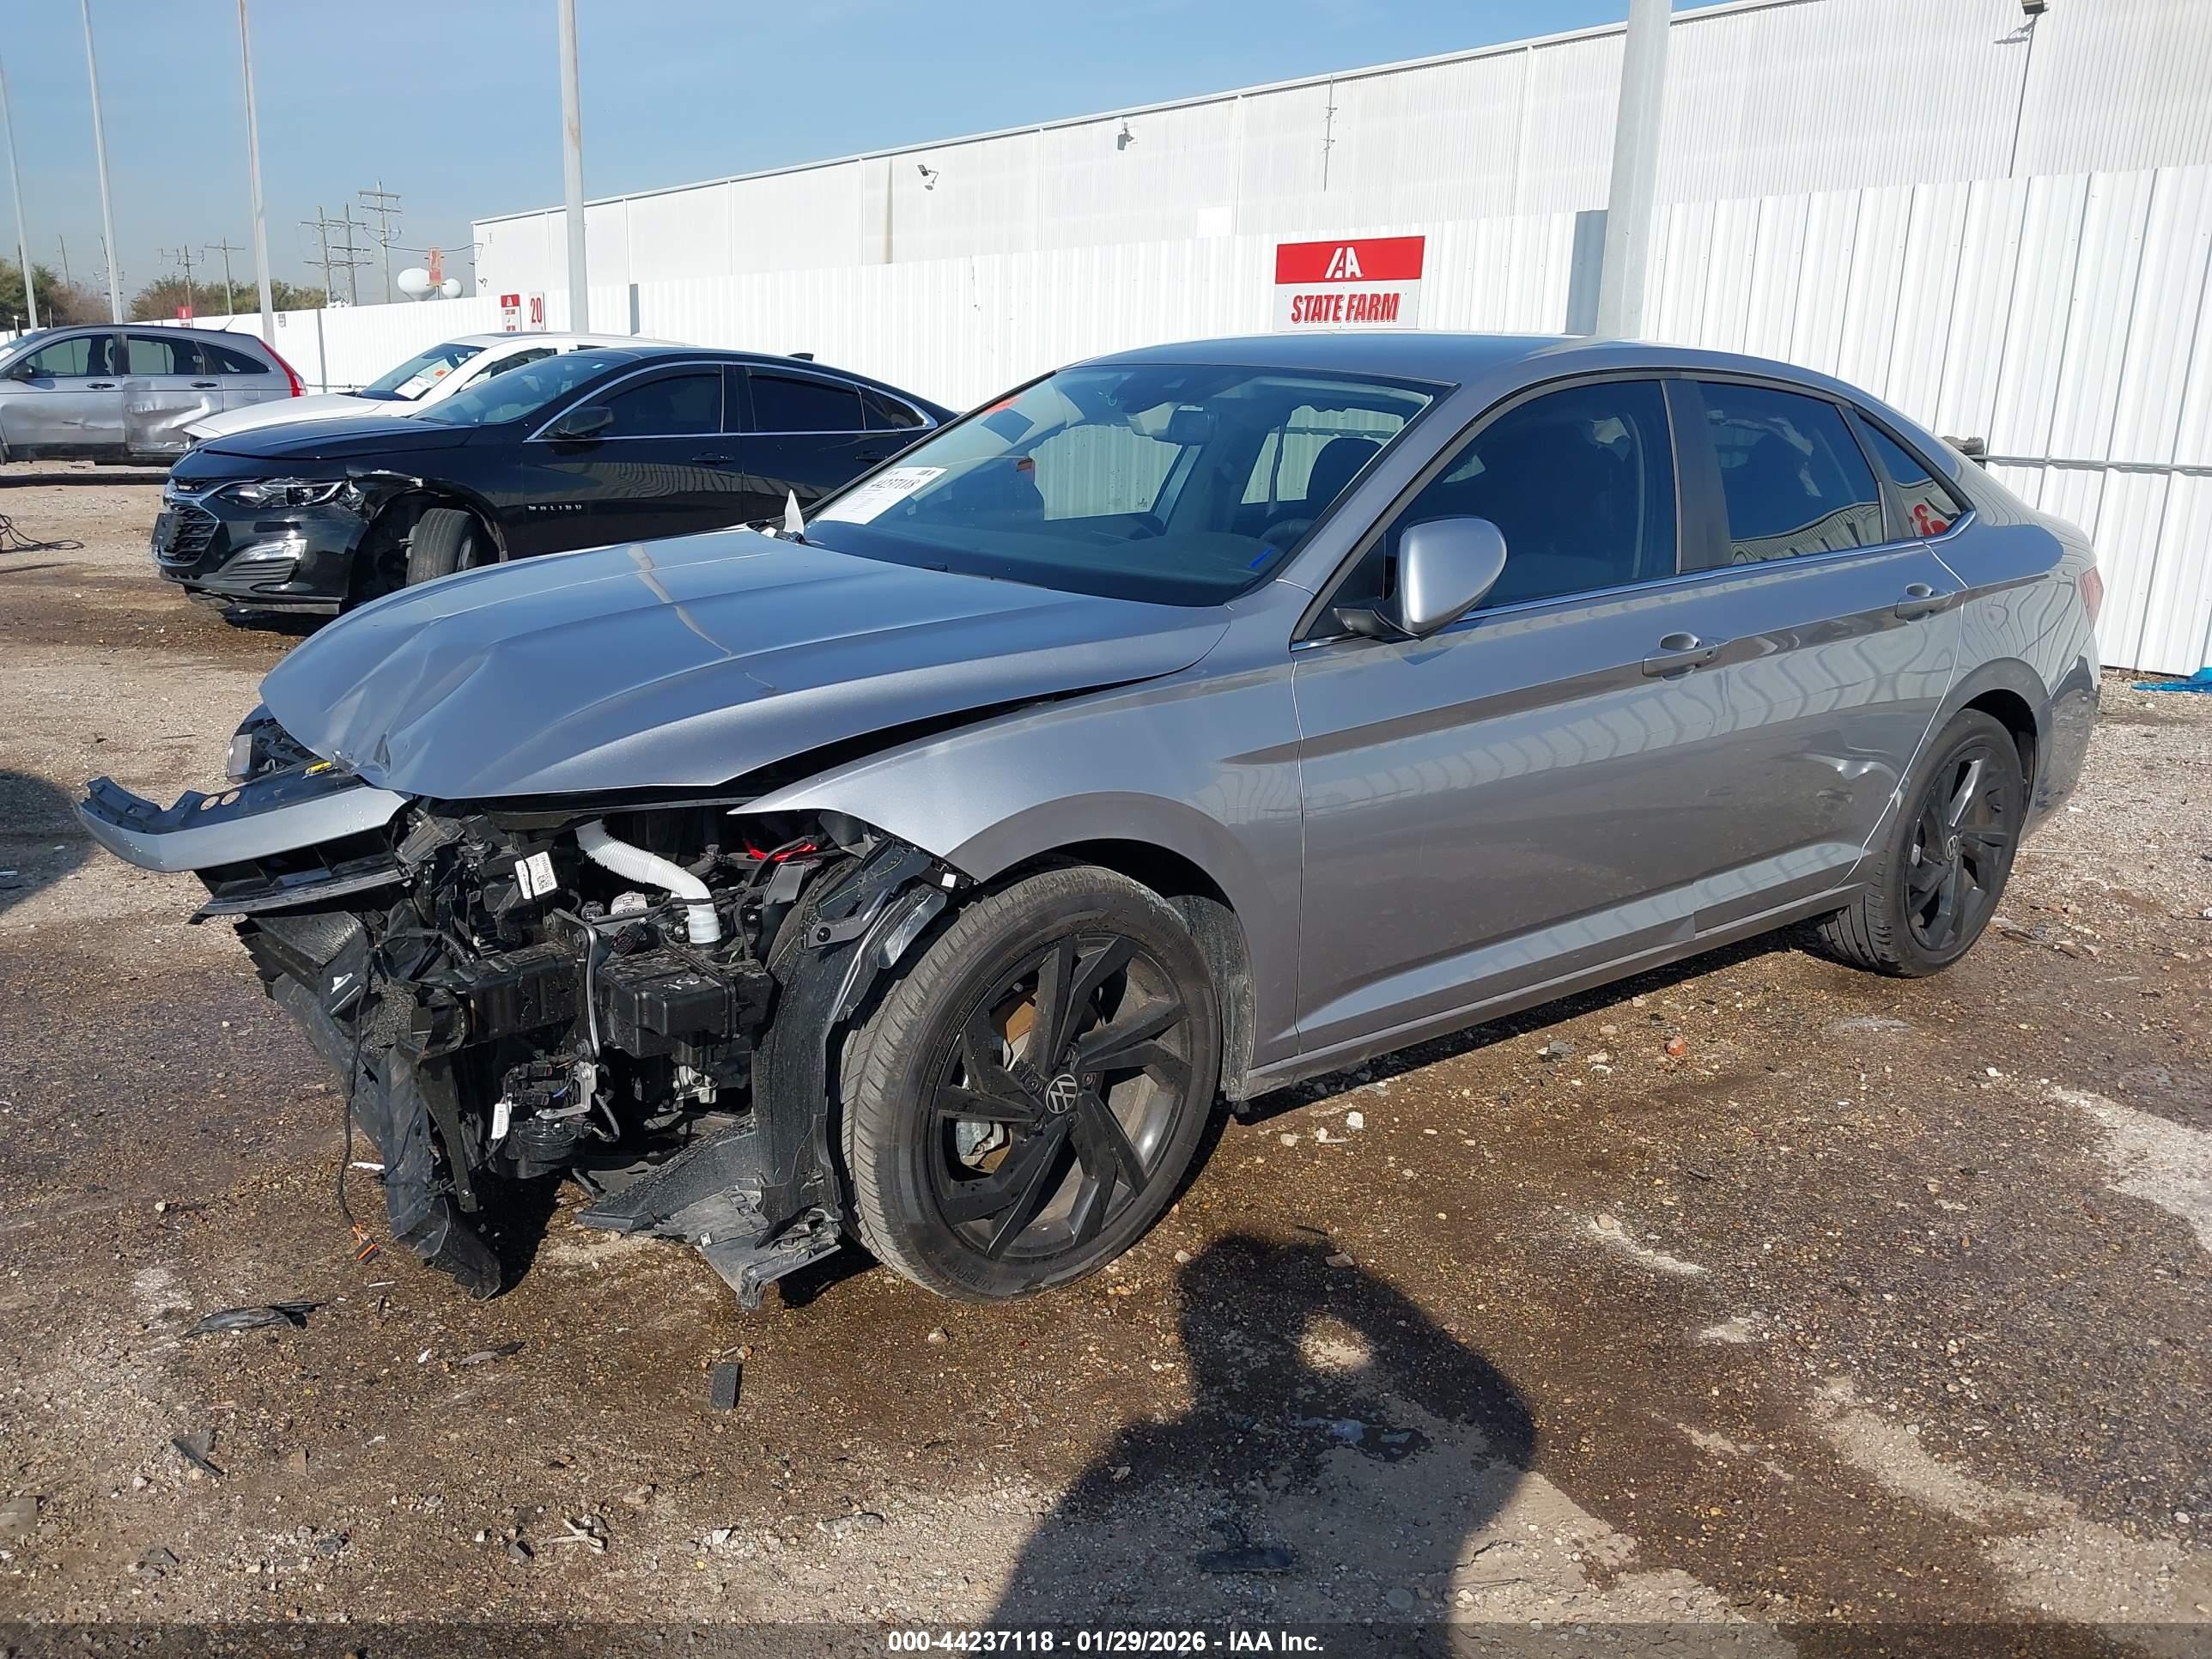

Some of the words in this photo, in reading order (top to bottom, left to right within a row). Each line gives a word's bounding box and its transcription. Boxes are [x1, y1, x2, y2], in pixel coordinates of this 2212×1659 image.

[530, 297, 543, 324] 20
[1291, 294, 1344, 324] STATE
[1345, 293, 1401, 323] FARM
